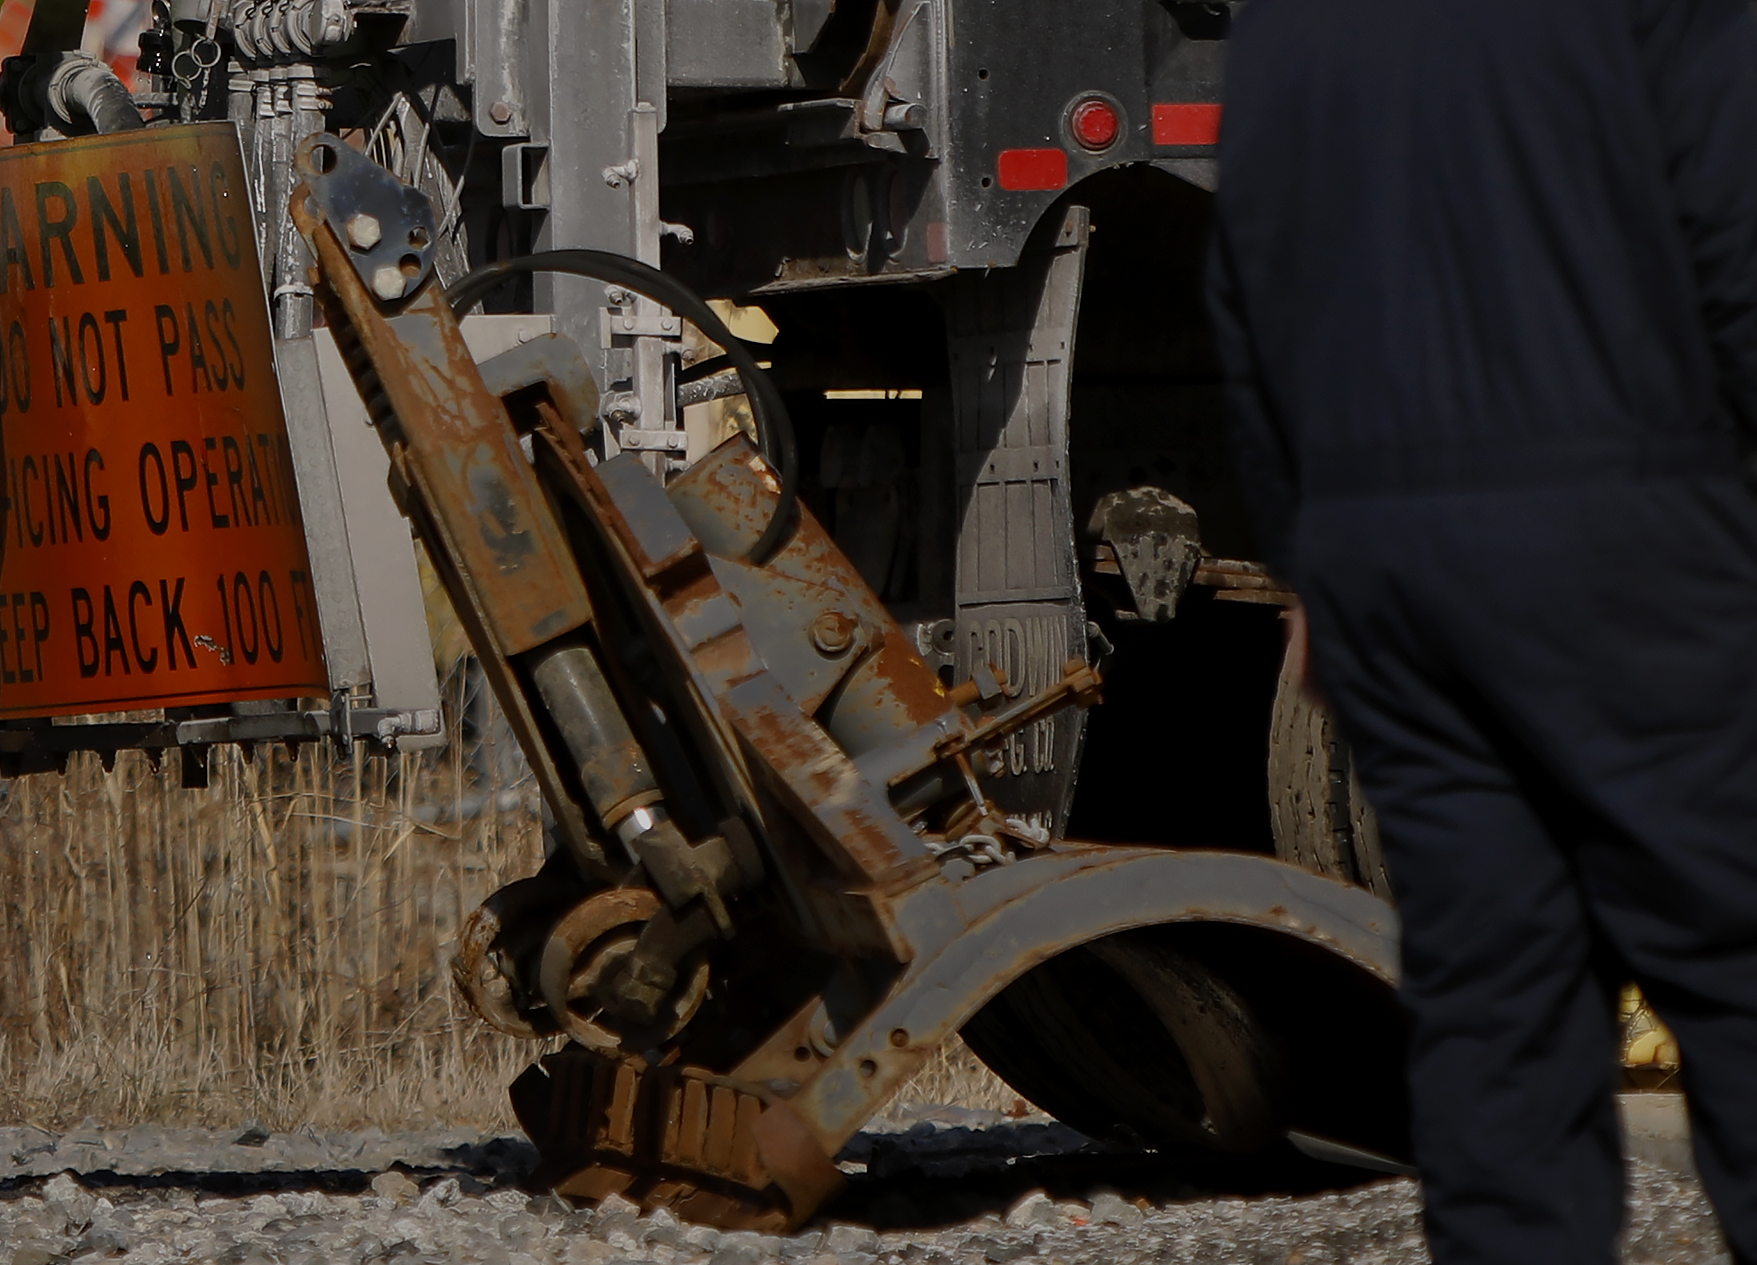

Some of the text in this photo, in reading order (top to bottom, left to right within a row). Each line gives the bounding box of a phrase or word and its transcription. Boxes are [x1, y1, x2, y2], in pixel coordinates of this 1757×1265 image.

[49, 309, 131, 409] NOT
[155, 296, 245, 398] PASS
[71, 577, 198, 679] BACK
[218, 570, 285, 666] 100
